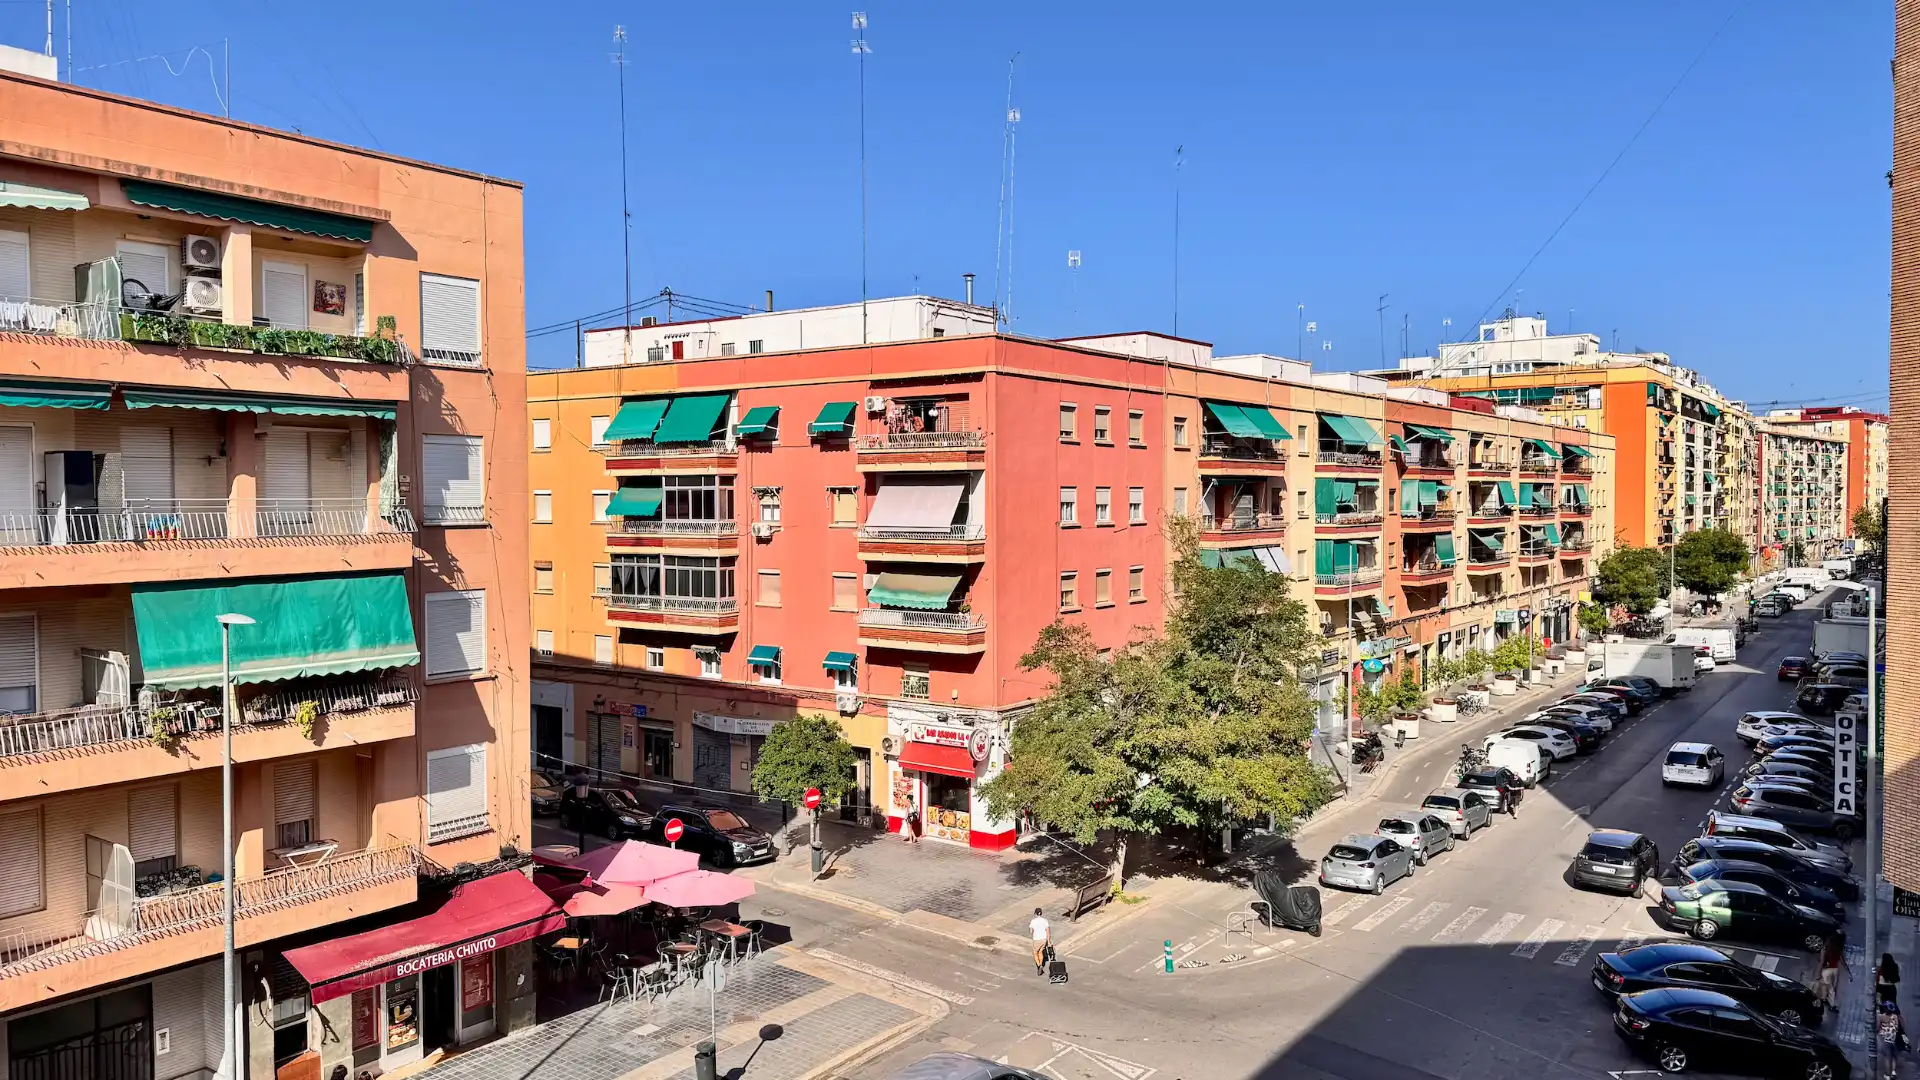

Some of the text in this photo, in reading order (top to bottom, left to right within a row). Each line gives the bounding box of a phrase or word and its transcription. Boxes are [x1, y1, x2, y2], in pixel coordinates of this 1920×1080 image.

[1837, 716, 1853, 812] OPTICA
[397, 950, 455, 976] BOCATERIA
[456, 937, 496, 958] CHIVITO
